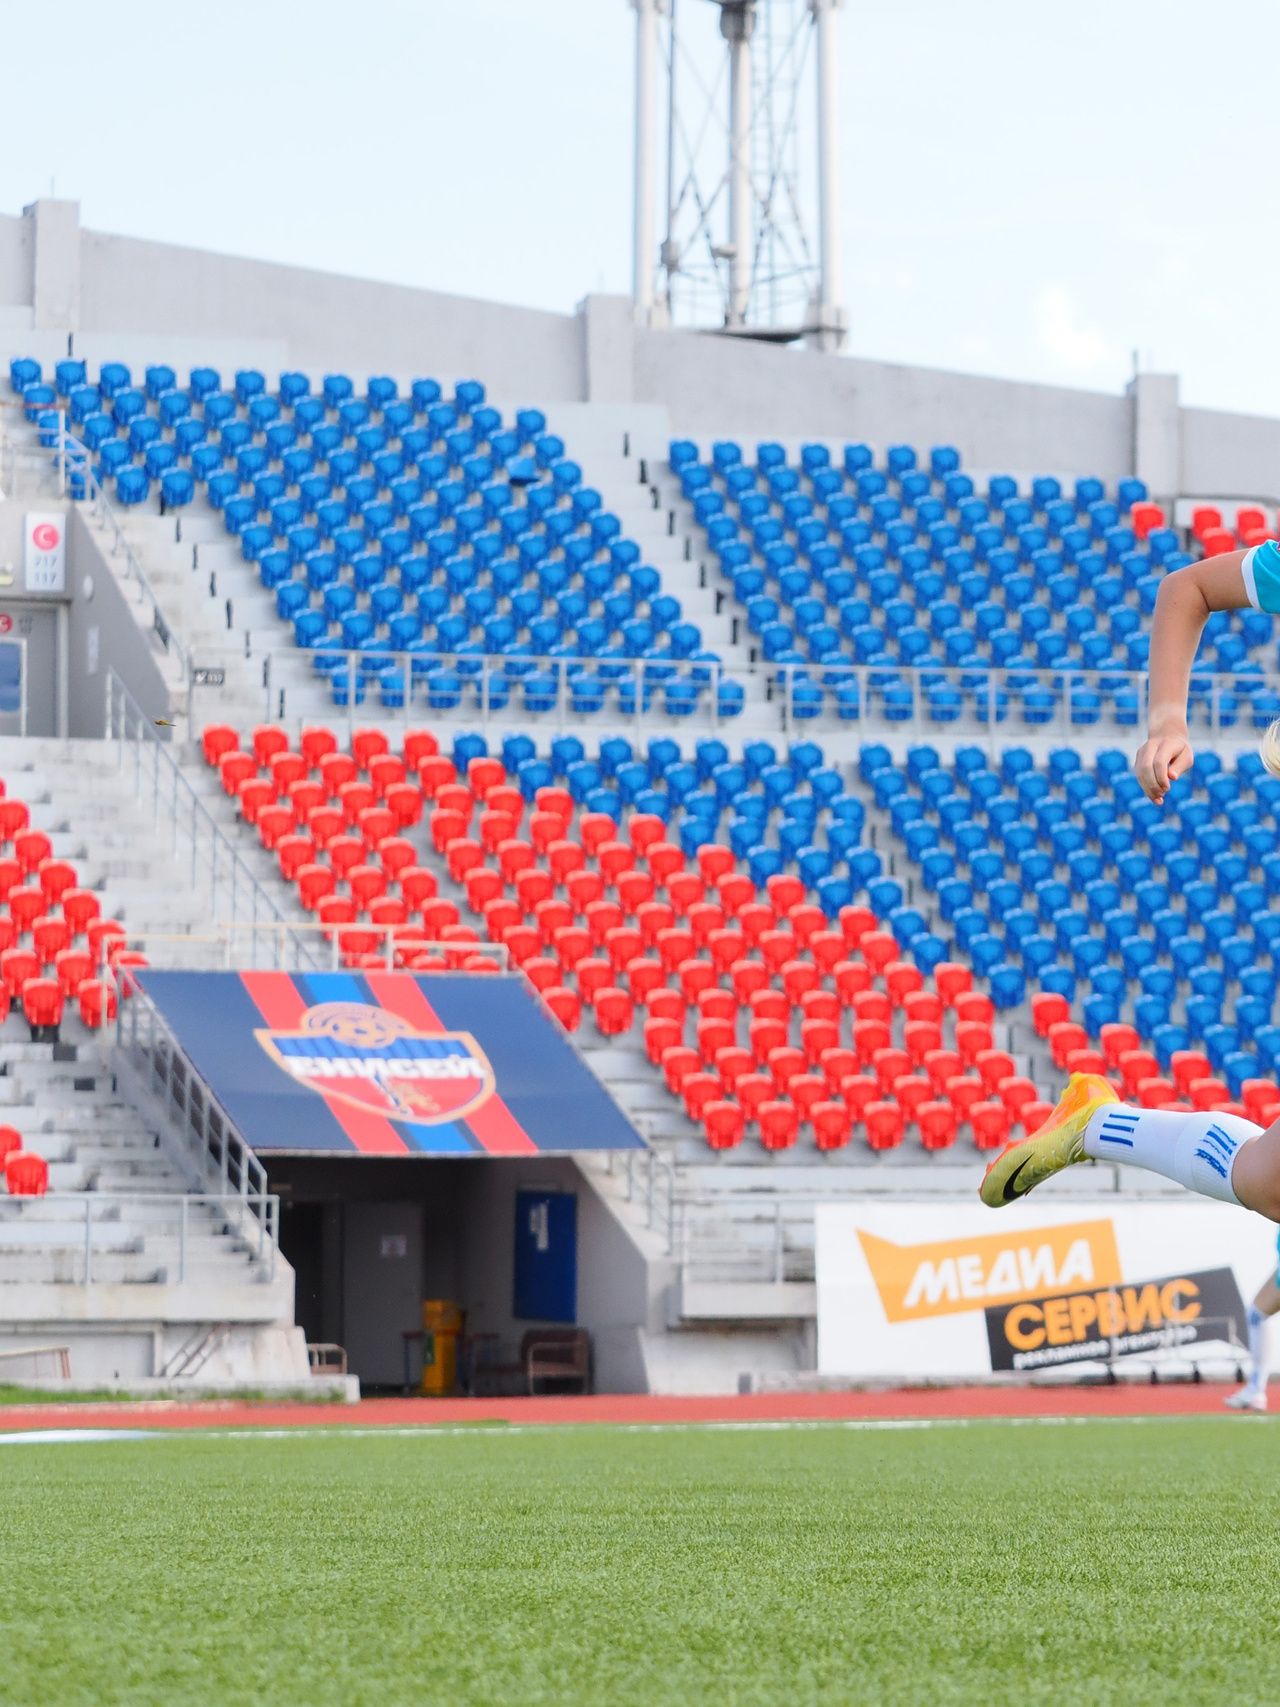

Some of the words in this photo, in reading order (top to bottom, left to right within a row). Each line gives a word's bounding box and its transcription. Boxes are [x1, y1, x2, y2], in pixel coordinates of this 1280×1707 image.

[283, 1054, 486, 1079] ЕНИСЕЙ
[902, 1239, 1095, 1309] МЕДИА
[1004, 1278, 1203, 1351] СЕРВИС
